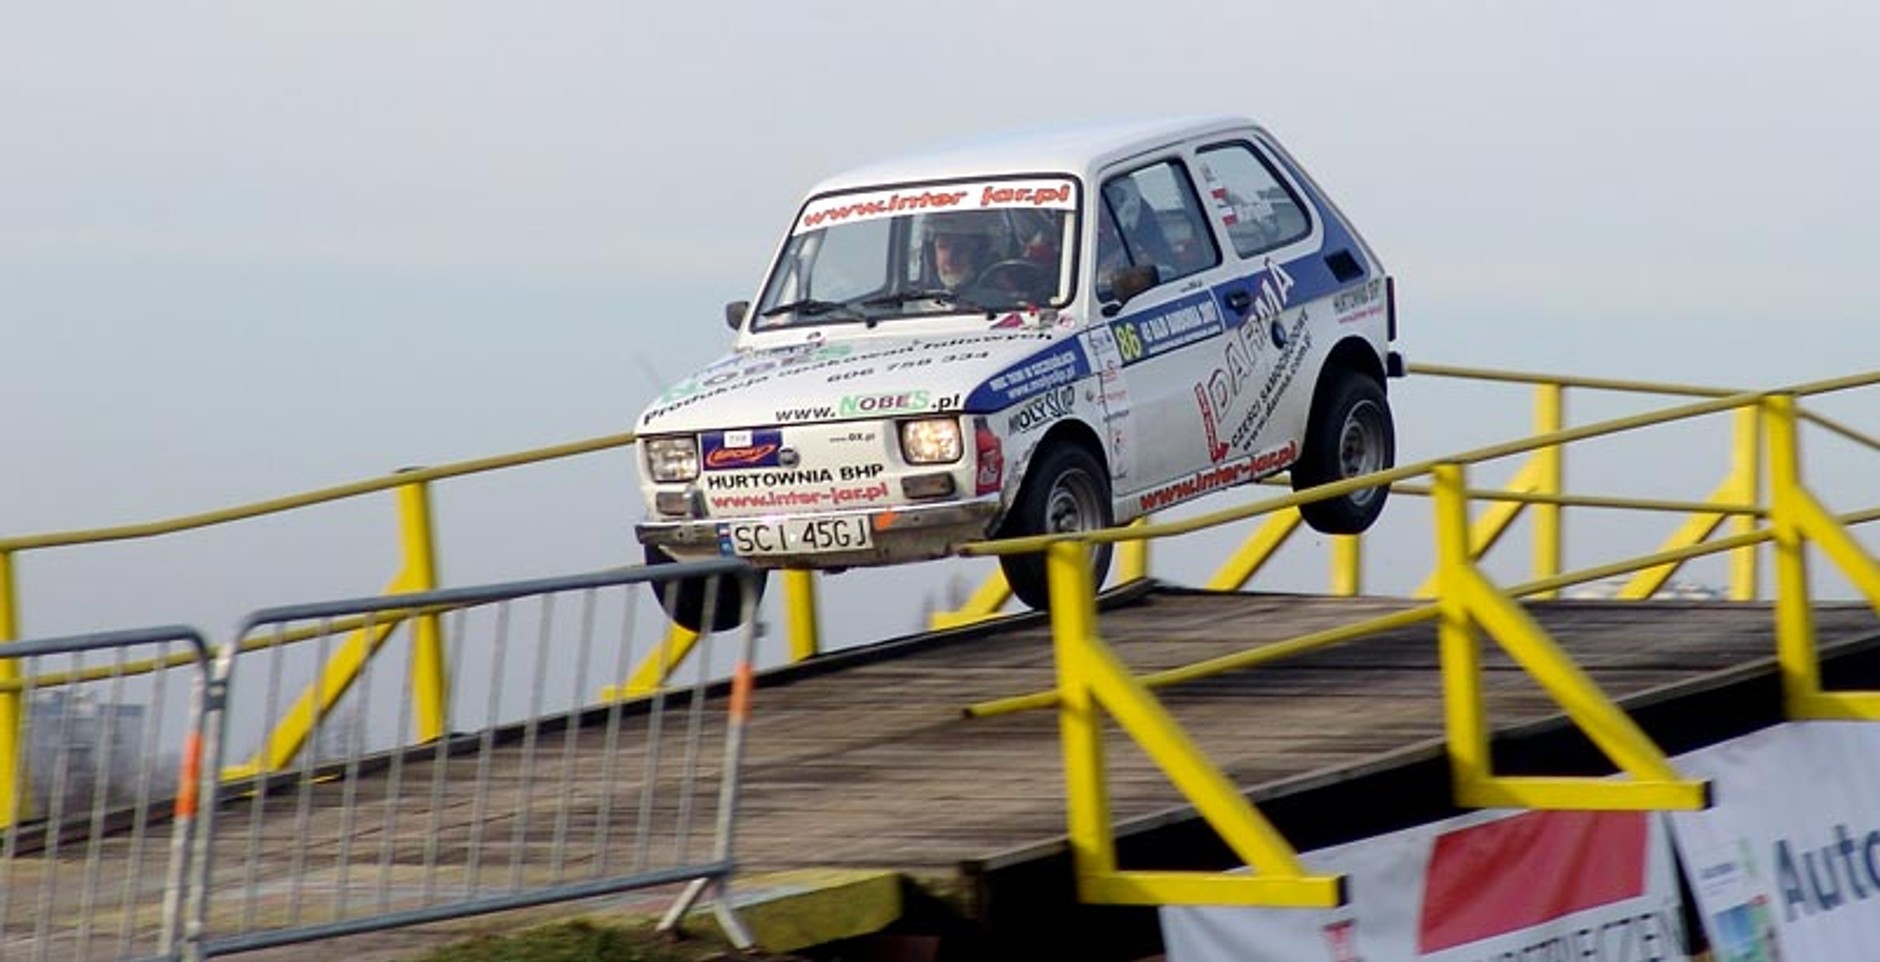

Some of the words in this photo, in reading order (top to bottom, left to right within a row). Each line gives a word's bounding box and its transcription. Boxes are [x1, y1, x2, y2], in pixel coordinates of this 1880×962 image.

[1114, 321, 1142, 360] 86
[707, 470, 833, 491] HURTOWNIA
[840, 463, 885, 481] BHP
[1140, 439, 1298, 510] www.inter-jar.pl
[711, 482, 890, 509] www.inter-jar.pl
[735, 524, 787, 553] SCI
[803, 518, 867, 550] 45GJ
